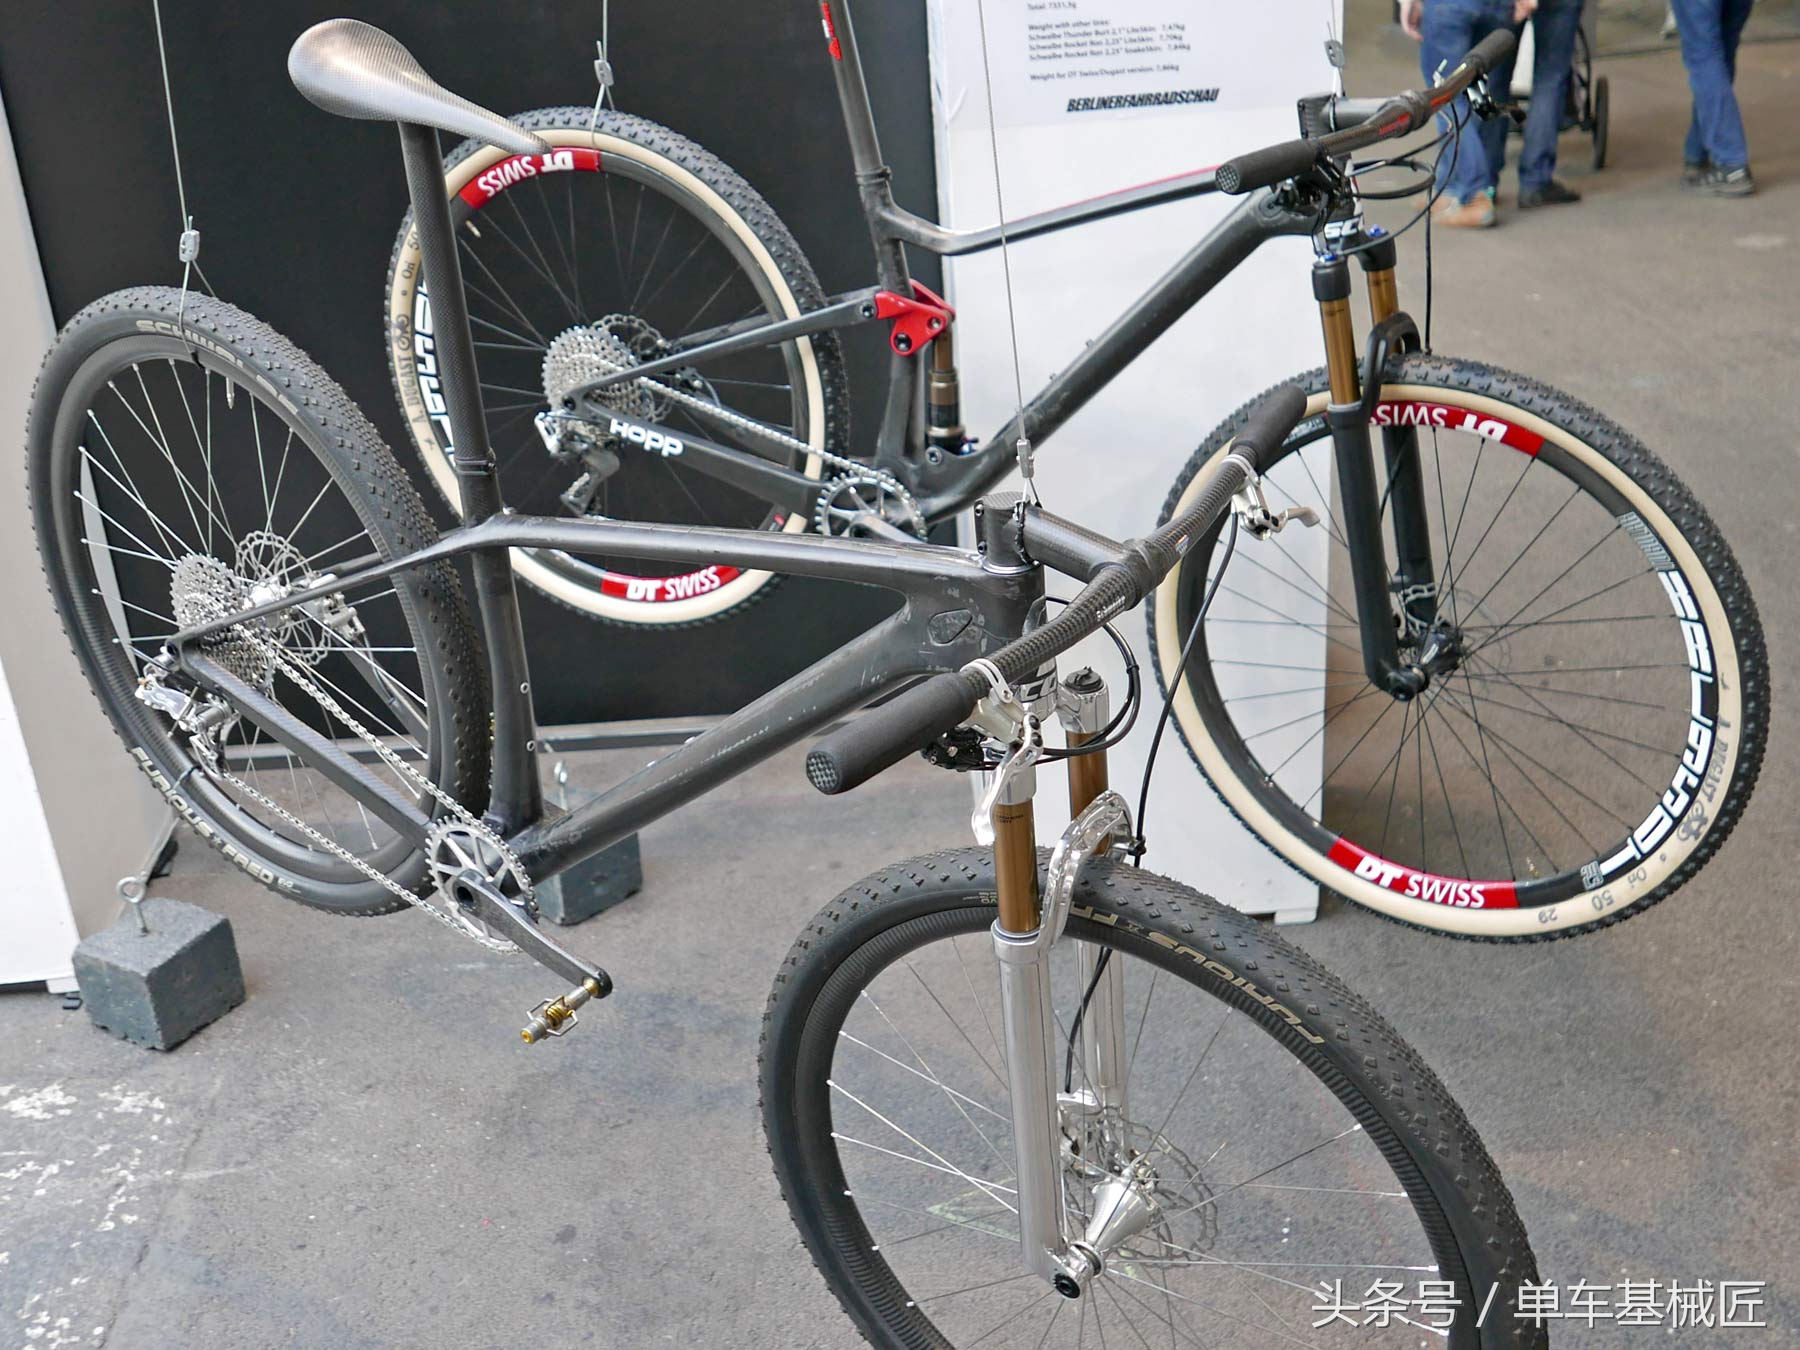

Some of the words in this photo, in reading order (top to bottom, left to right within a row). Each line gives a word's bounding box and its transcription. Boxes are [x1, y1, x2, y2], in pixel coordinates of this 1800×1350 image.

[1067, 87, 1220, 112] BERLINERFAHRRADSCHAU
[477, 155, 537, 198] SWISS
[541, 150, 575, 173] DT
[1456, 412, 1508, 441] DT
[626, 579, 662, 601] DT
[664, 566, 720, 601] SWISS
[131, 746, 214, 838] FURIOUS
[222, 843, 275, 885] FRED
[1353, 855, 1404, 889] DT
[1404, 873, 1485, 909] SWISS
[1148, 931, 1326, 1045] FURIOUS
